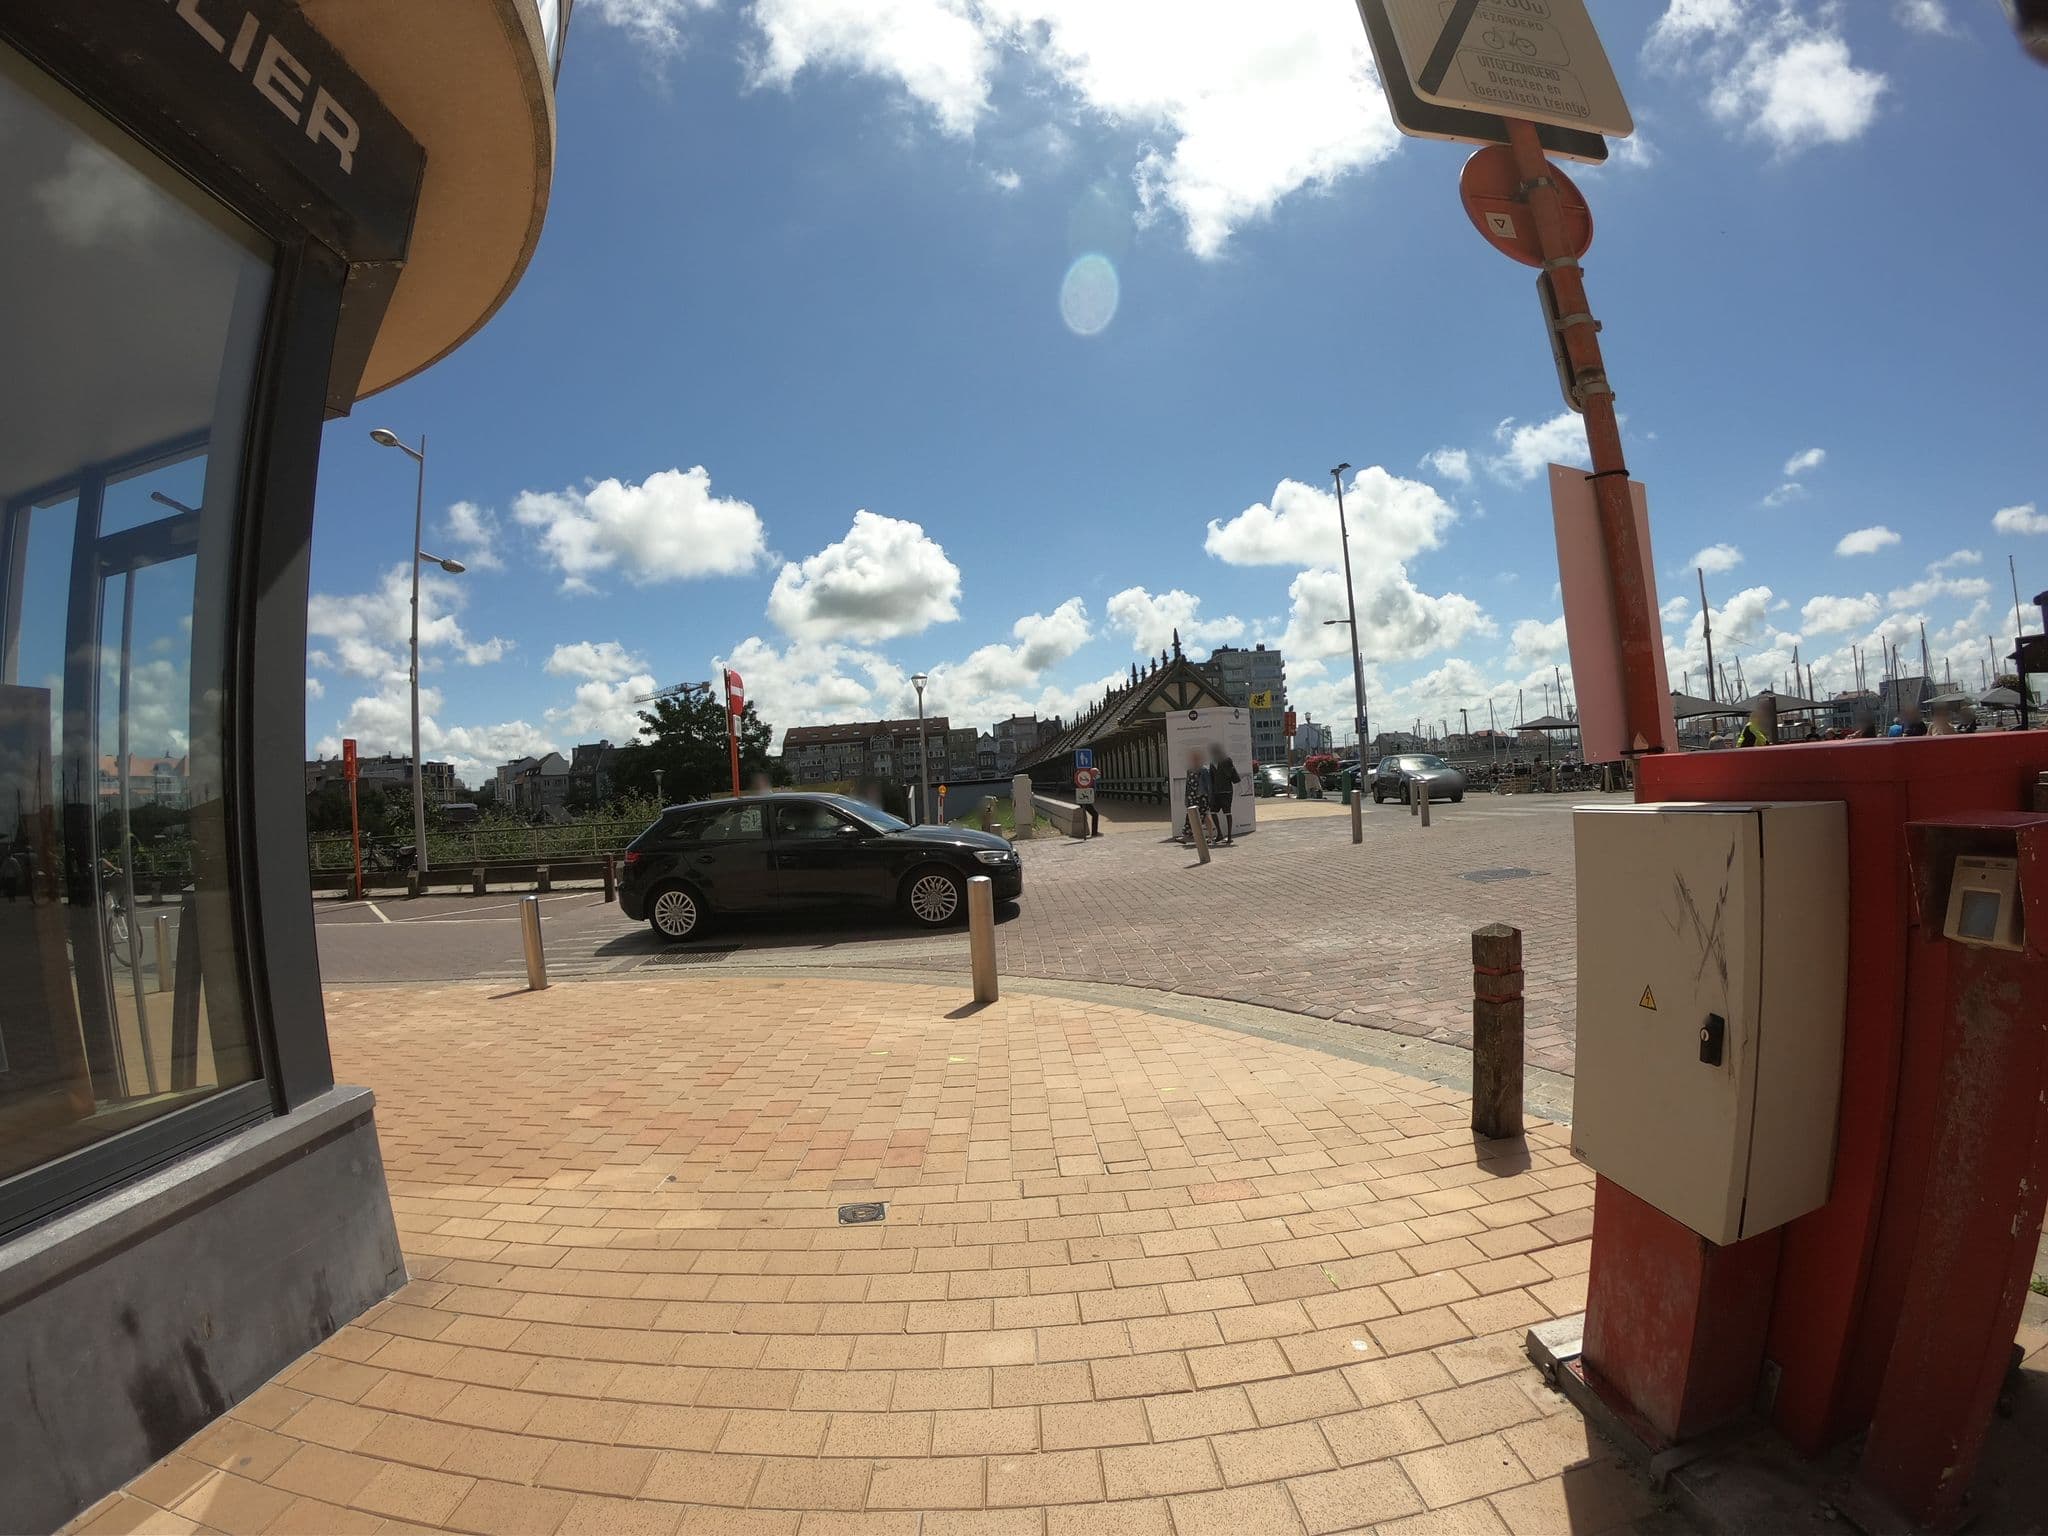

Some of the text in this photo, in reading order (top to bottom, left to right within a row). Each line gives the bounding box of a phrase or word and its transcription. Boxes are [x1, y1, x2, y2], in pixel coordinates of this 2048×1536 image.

[1477, 55, 1561, 82] UITGEZONDERD
[1488, 70, 1562, 97] Diensten en
[162, 0, 360, 176] LIER
[1471, 81, 1588, 118] Toeristisch treintje
